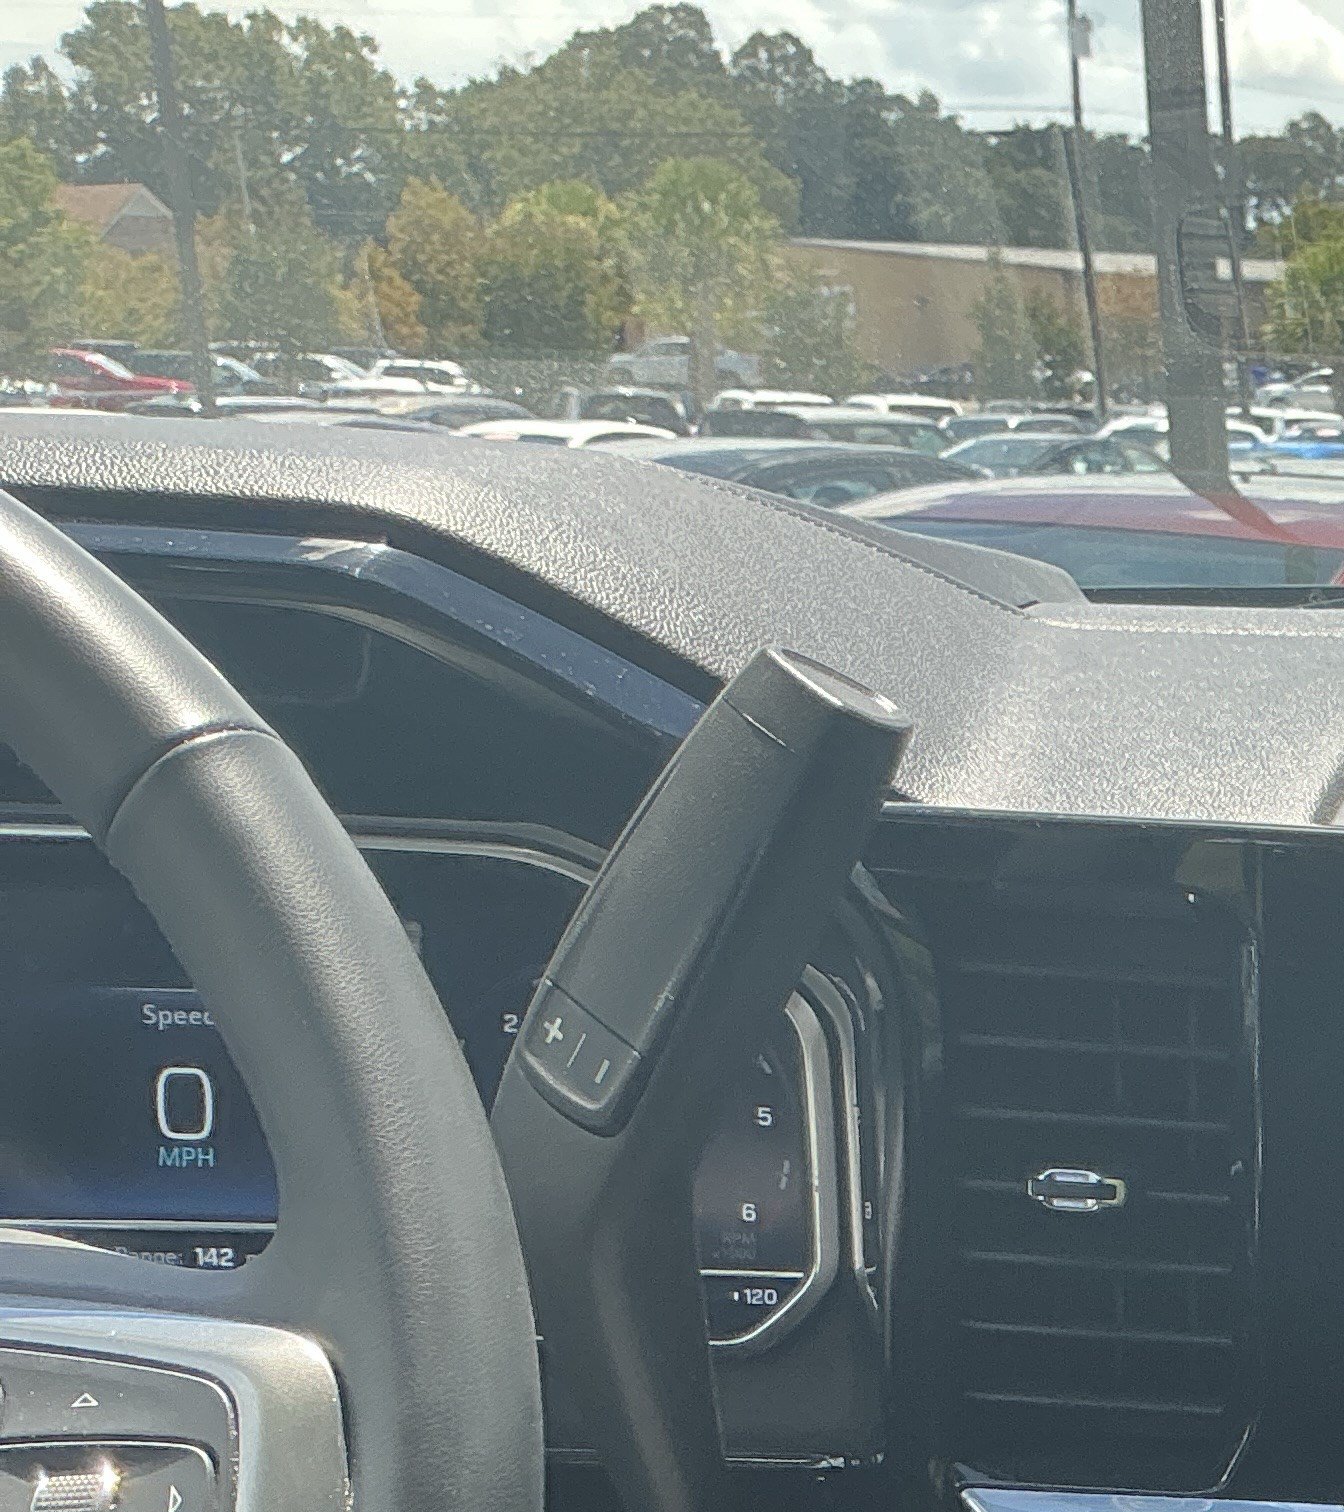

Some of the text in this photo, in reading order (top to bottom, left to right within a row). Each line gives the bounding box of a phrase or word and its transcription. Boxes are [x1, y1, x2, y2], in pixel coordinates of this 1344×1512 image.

[502, 1013, 519, 1034] 2
[156, 1067, 214, 1141] 0
[757, 1107, 773, 1126] 5
[158, 1146, 214, 1167] MPH
[741, 1203, 757, 1222] 6
[194, 1247, 235, 1267] 142
